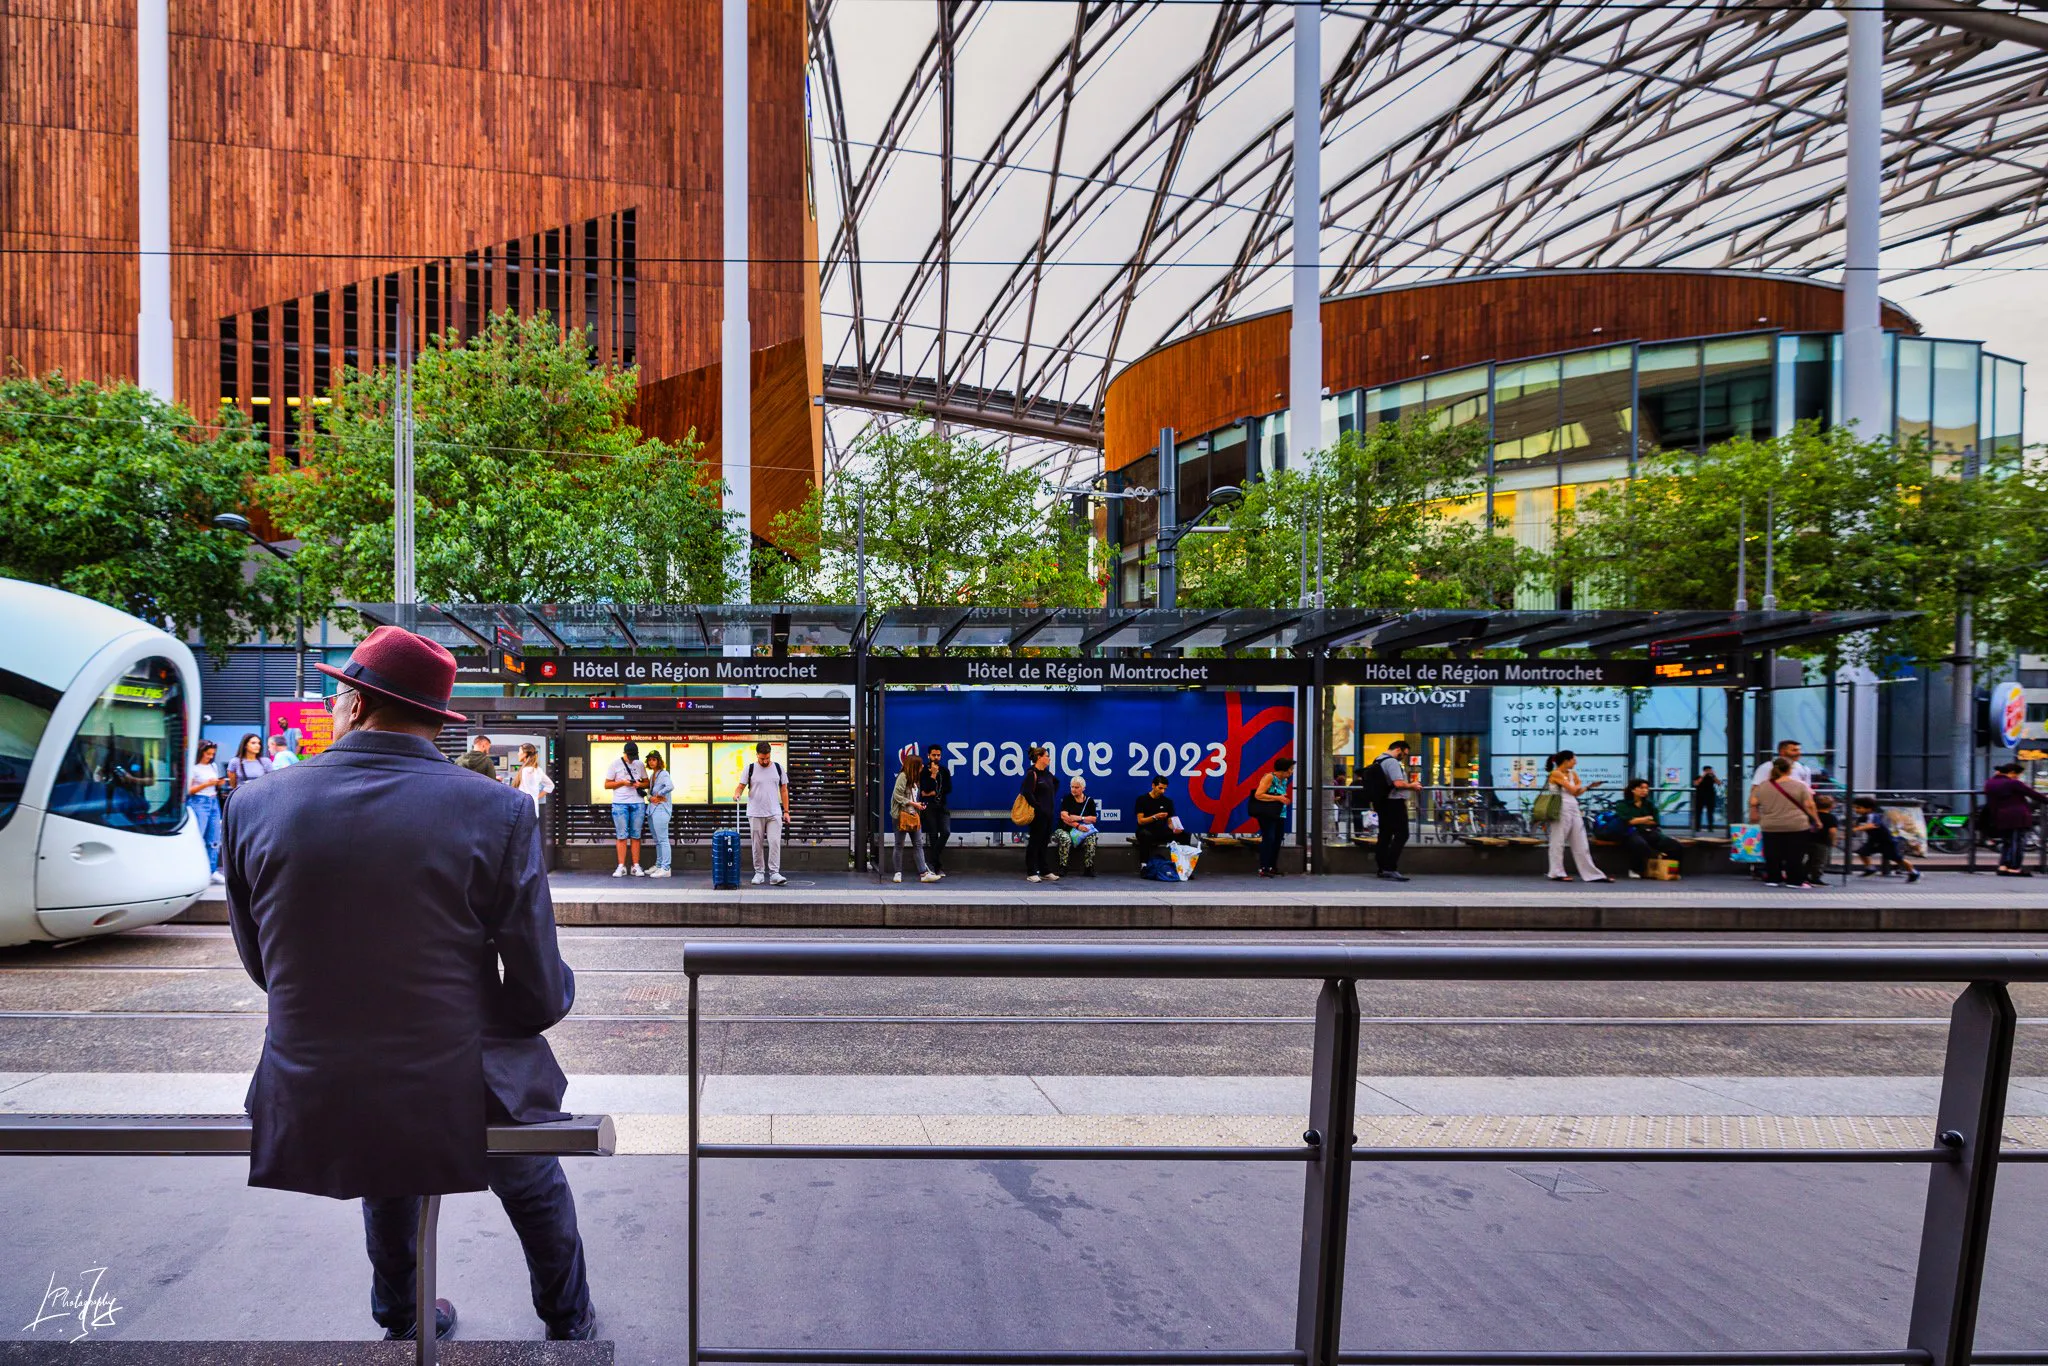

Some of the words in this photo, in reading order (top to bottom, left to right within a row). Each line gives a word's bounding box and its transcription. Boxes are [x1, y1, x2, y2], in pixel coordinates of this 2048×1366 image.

[573, 661, 619, 678] Hôtel
[625, 662, 646, 678] de
[652, 662, 709, 683] Région
[716, 662, 817, 678] Montrochet
[968, 662, 1013, 679] Hôtel
[1019, 663, 1040, 679] de
[1046, 663, 1103, 683] Région
[1110, 663, 1208, 679] Montrochet
[1366, 664, 1411, 680] Hôtel
[1417, 664, 1437, 680] de
[1443, 664, 1498, 683] Région
[1506, 665, 1603, 680] Montrochet
[1507, 702, 1533, 711] VOS
[1504, 715, 1538, 724] SONT
[1546, 714, 1621, 723] OUVERTES
[1512, 729, 1528, 737] DE
[1573, 728, 1599, 736] 20H
[1128, 742, 1228, 777] 2023
